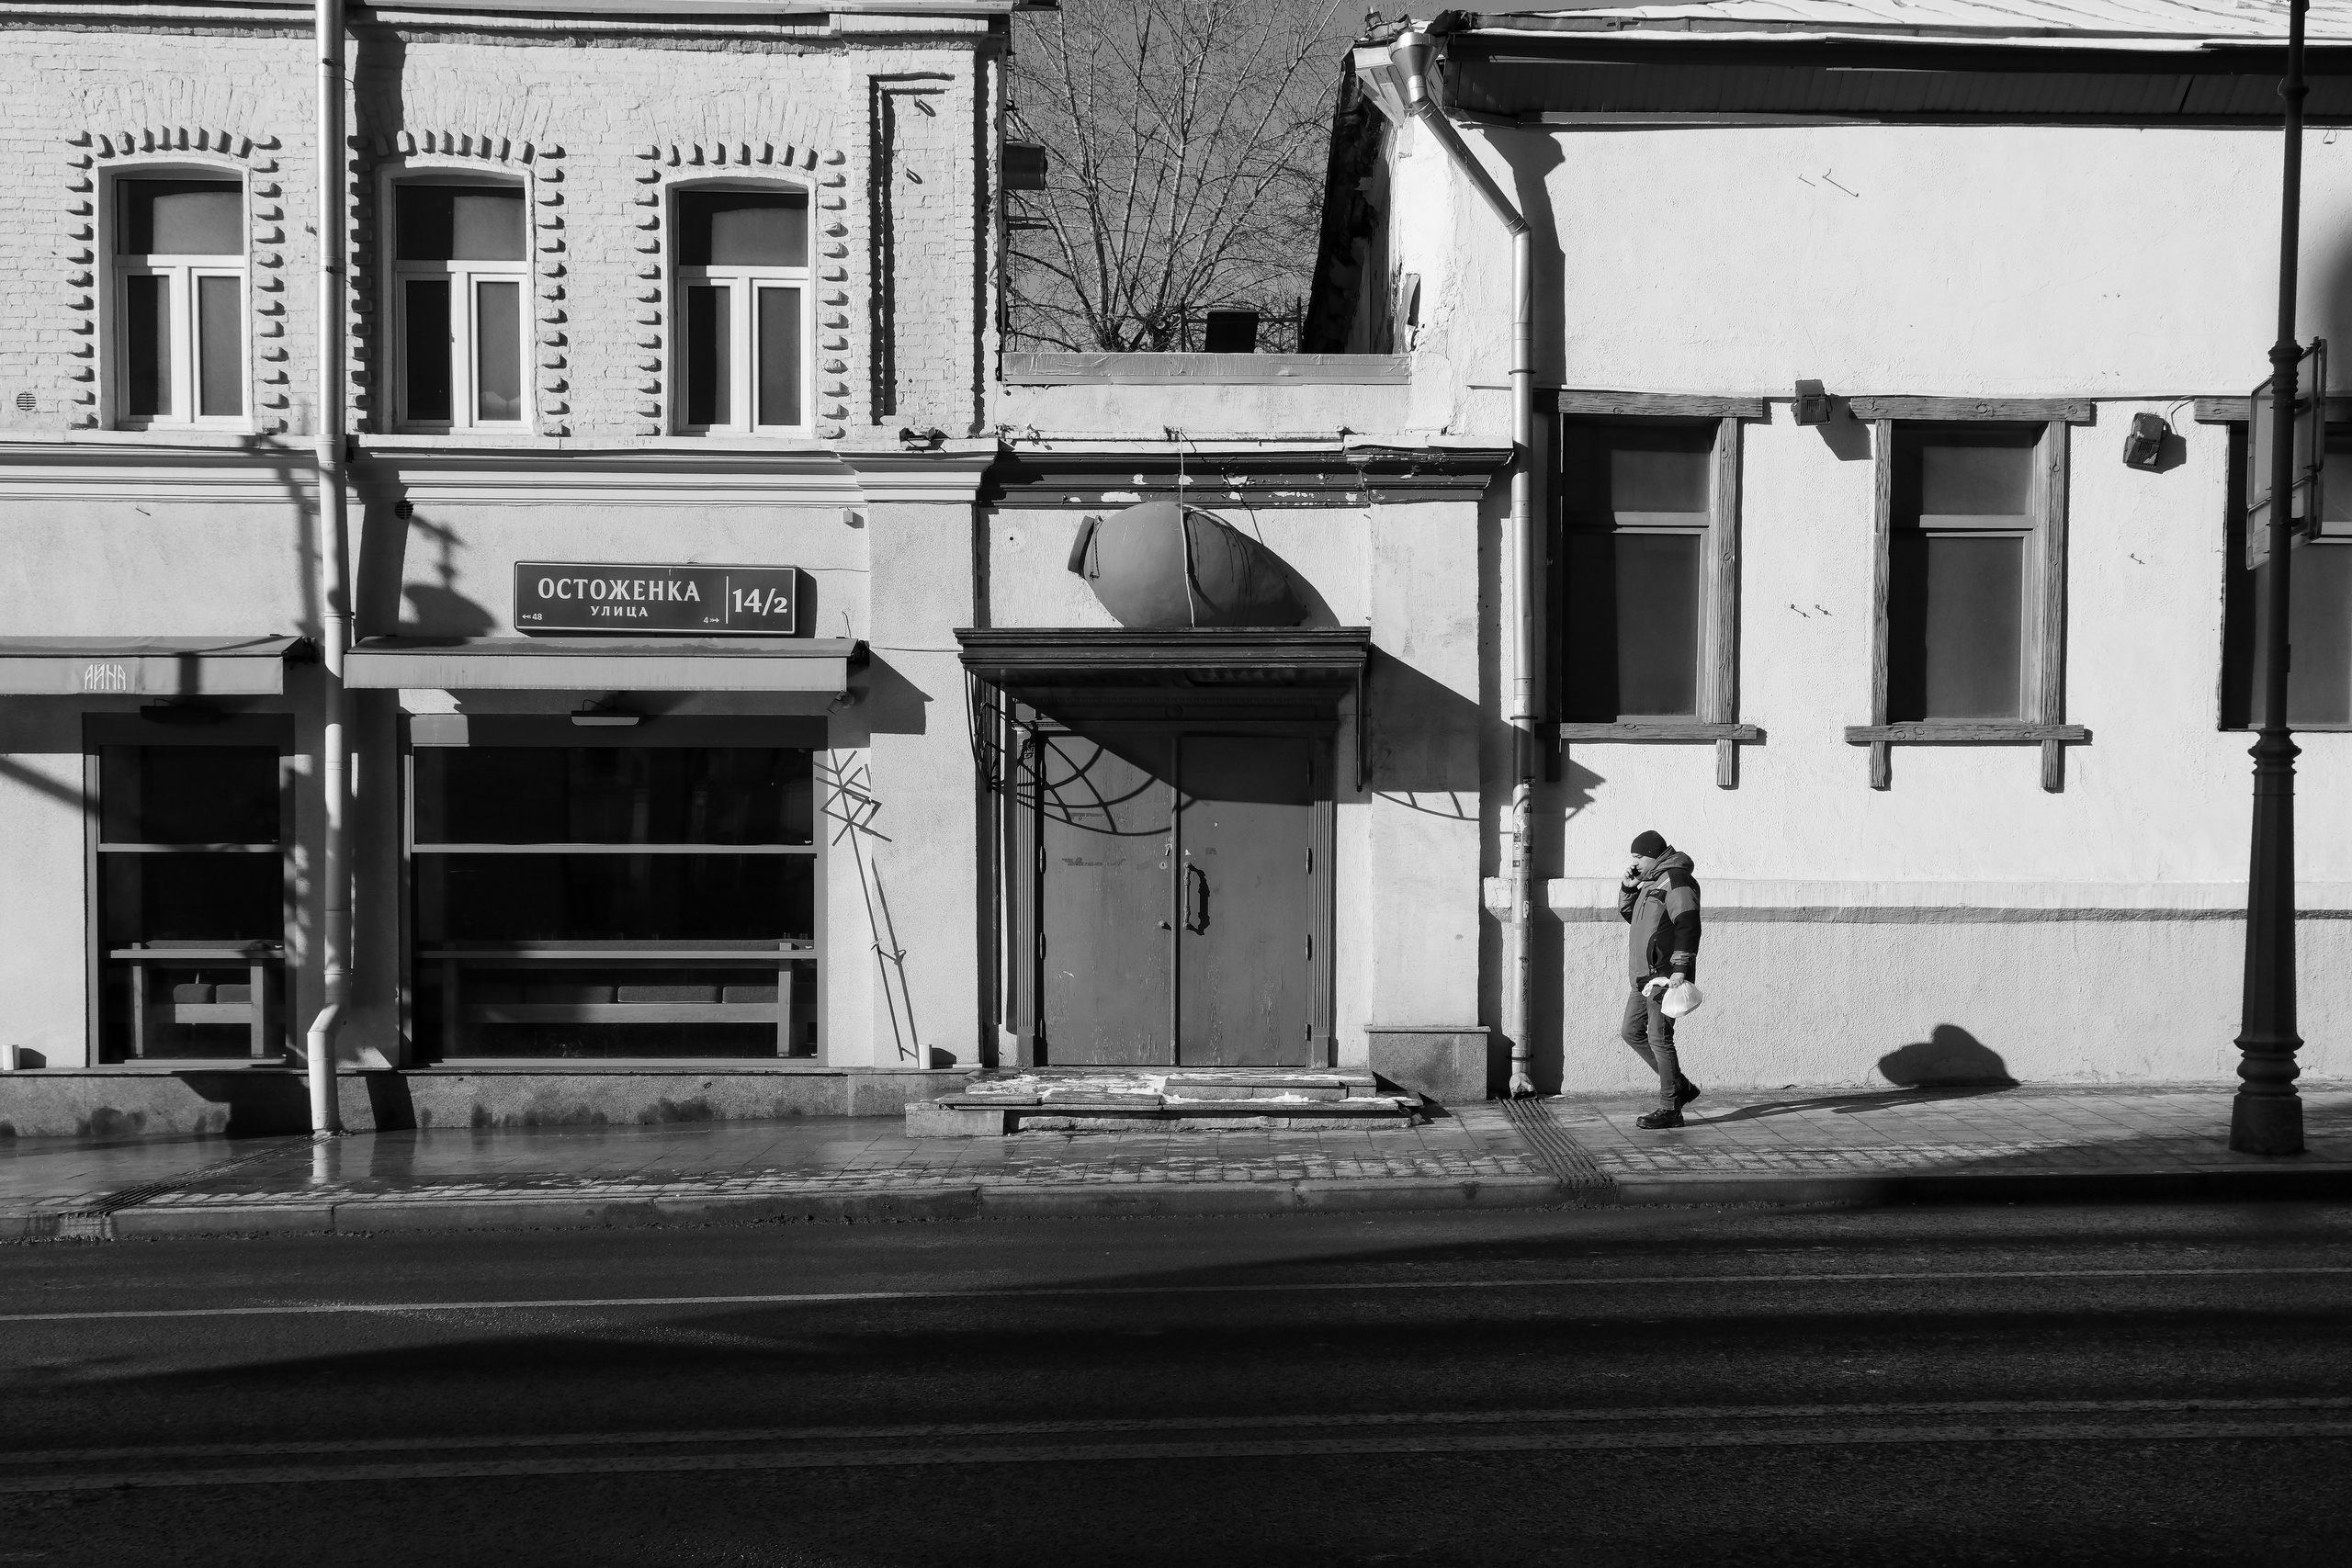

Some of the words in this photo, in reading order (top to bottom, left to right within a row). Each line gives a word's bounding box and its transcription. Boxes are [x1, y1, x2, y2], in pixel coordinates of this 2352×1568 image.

[537, 577, 701, 602] ОСТОЖЕНКА
[732, 587, 788, 616] 14/2
[532, 613, 543, 621] 48
[590, 605, 649, 618] УЛИЦА
